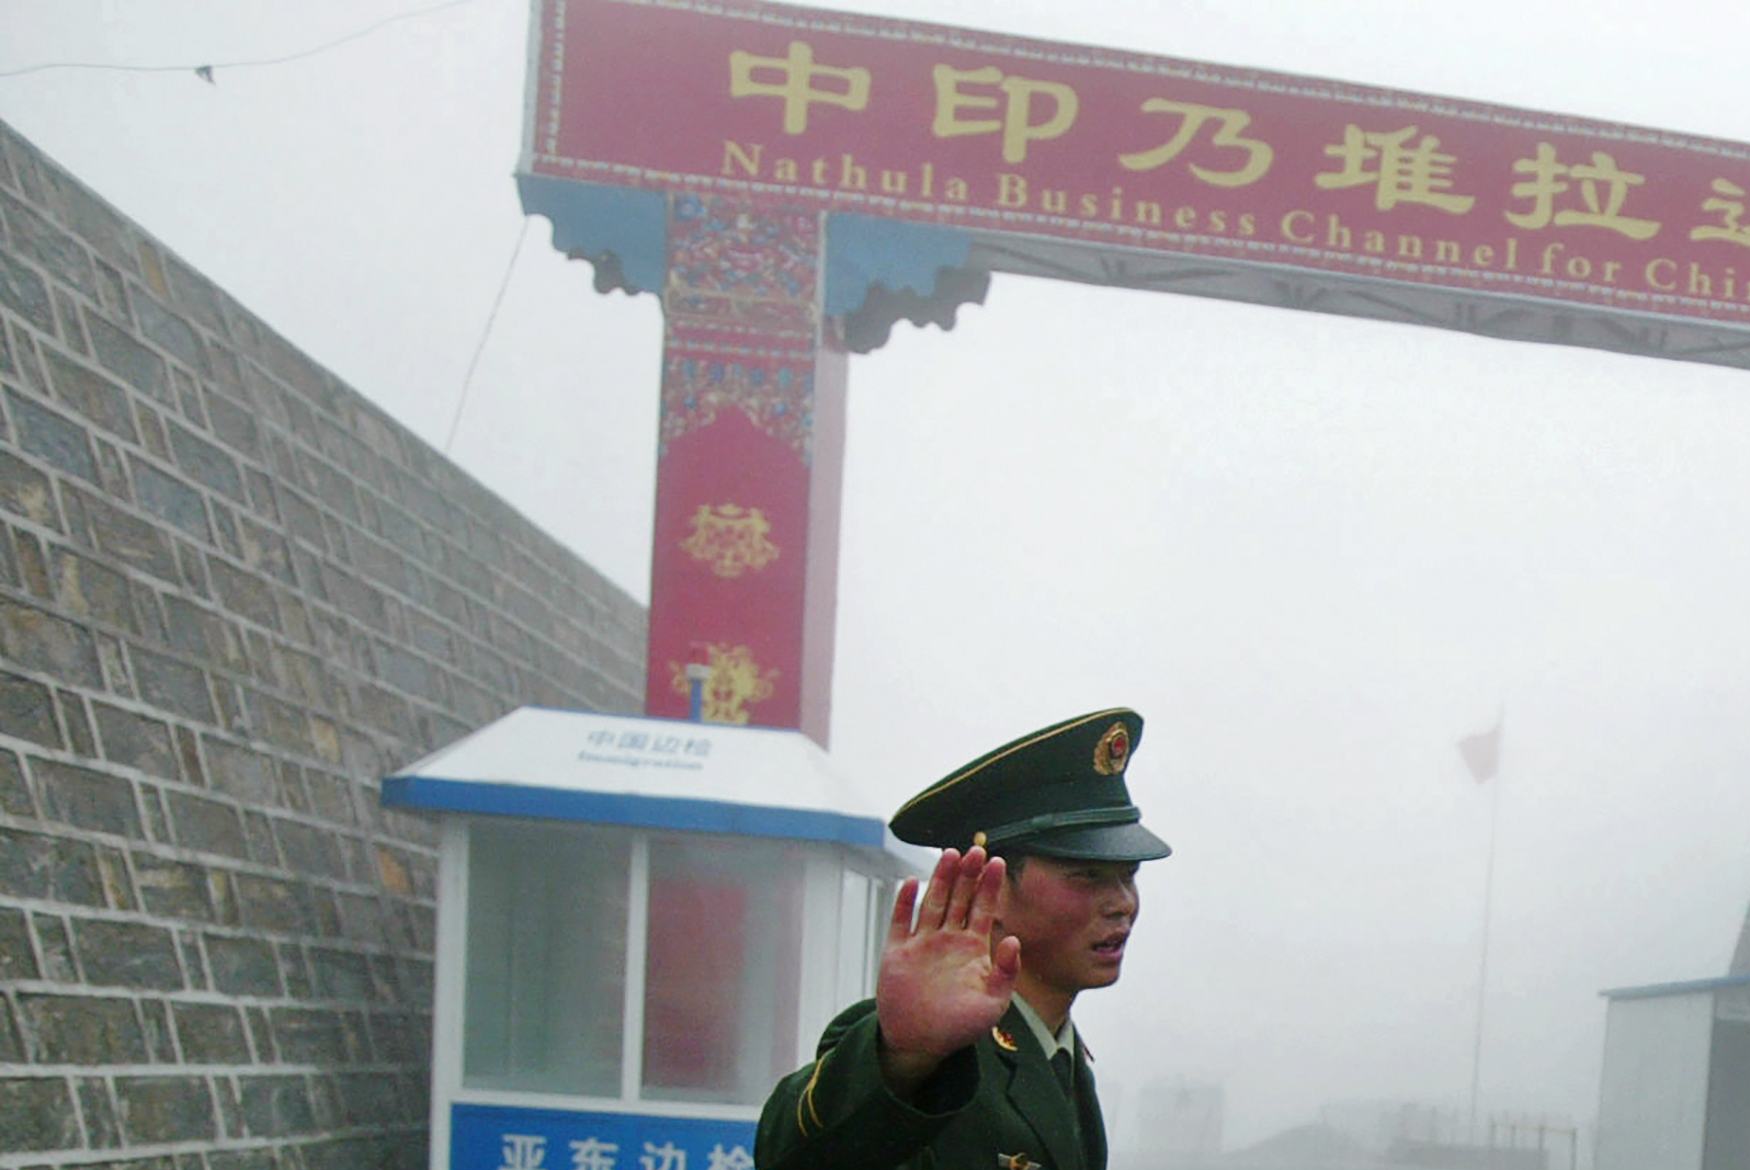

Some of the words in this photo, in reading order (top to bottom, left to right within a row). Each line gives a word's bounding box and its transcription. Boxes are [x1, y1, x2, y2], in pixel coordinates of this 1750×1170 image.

[720, 139, 969, 202] Nathula
[998, 172, 1256, 237] Business
[1280, 209, 1519, 273] Channel
[1541, 241, 1621, 283] for
